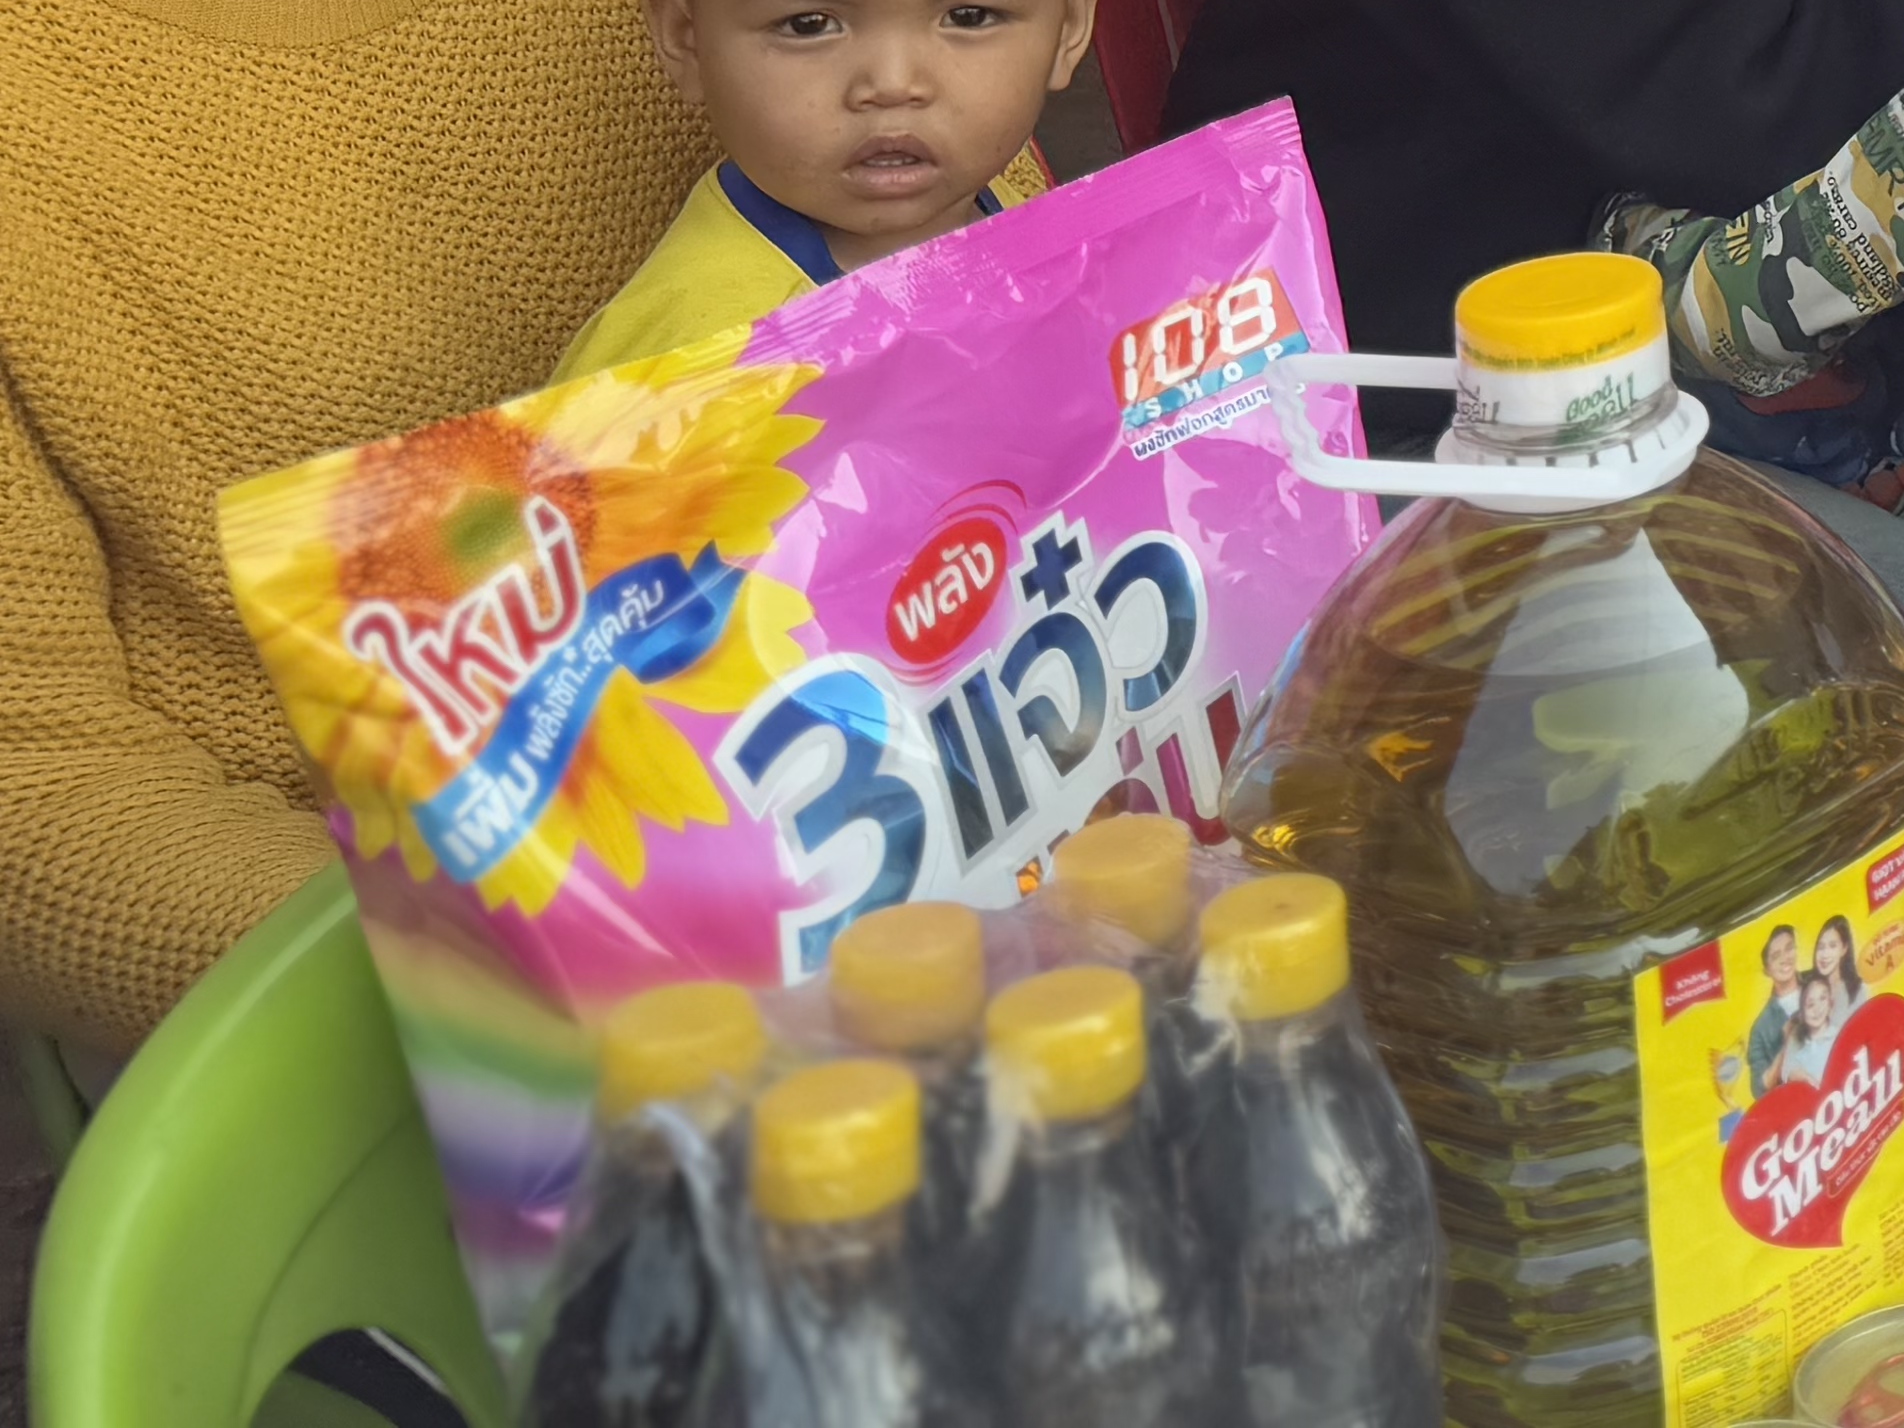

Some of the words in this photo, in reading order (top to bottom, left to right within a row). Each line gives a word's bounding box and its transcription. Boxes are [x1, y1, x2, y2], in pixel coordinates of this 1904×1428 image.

[1122, 275, 1276, 406] 108
[350, 496, 584, 755] ใหม่
[891, 532, 998, 645] พลัง
[1741, 1044, 1873, 1201] Good
[1768, 1049, 1904, 1238] Meall
